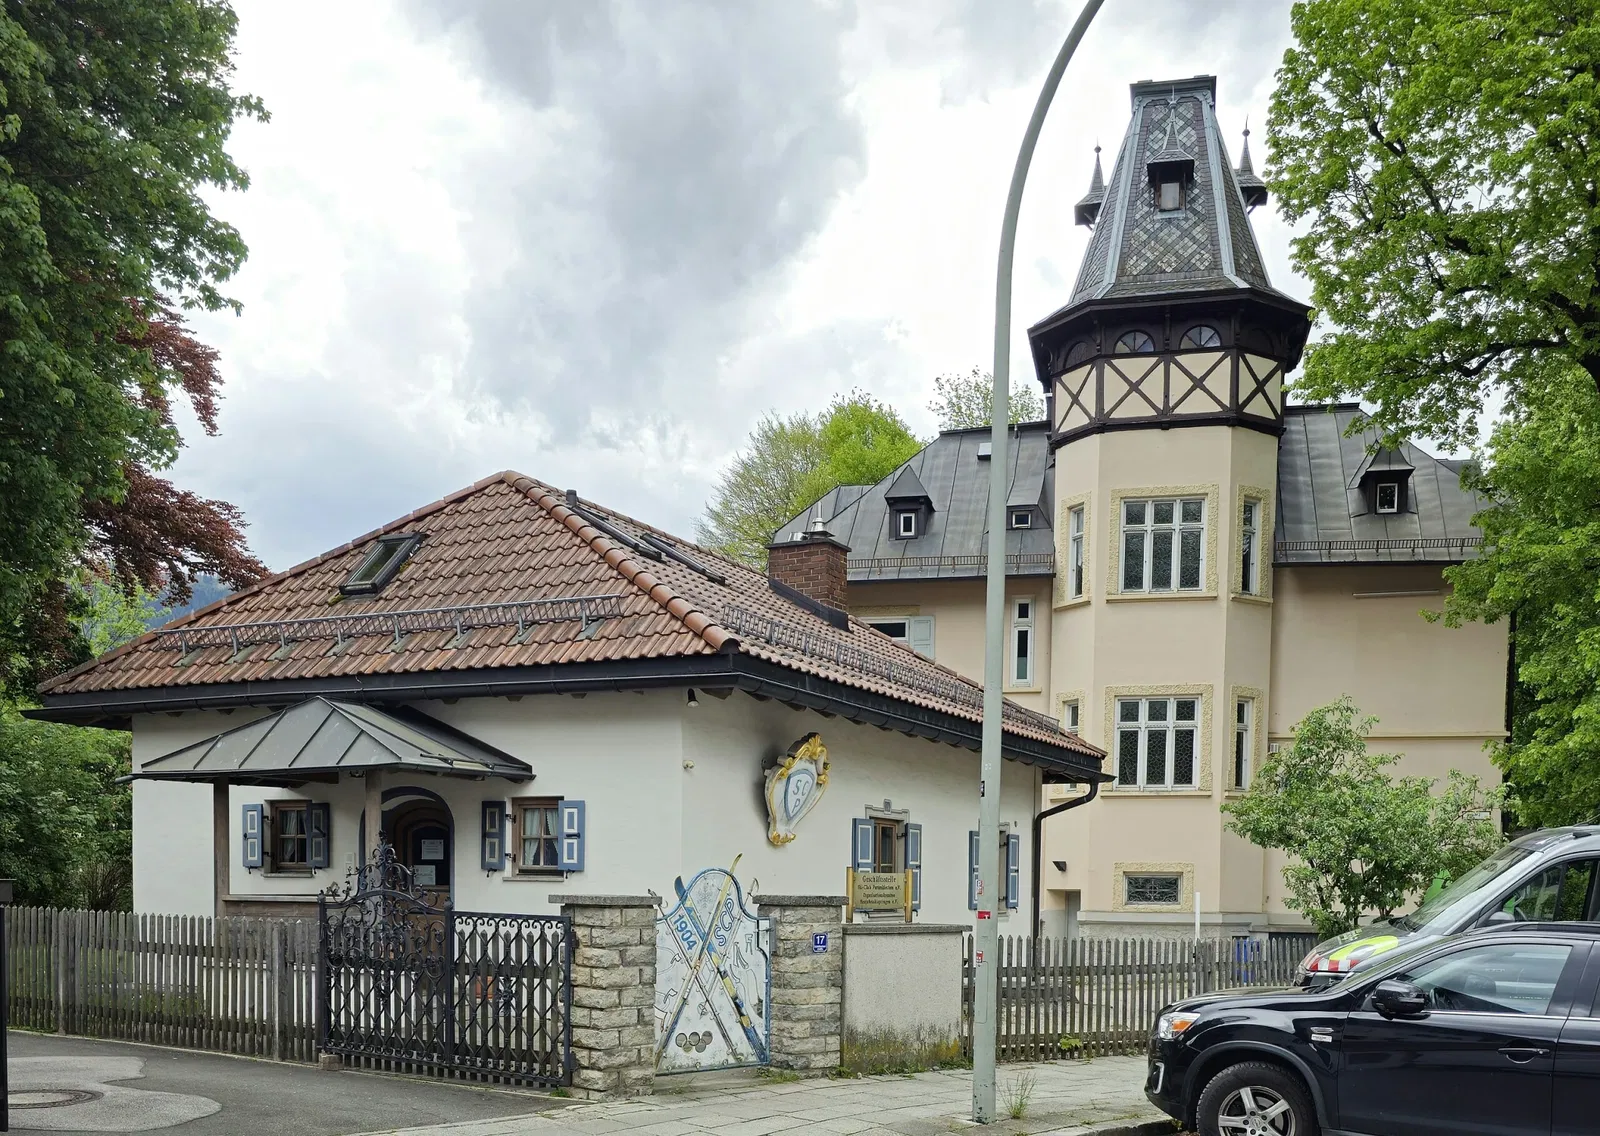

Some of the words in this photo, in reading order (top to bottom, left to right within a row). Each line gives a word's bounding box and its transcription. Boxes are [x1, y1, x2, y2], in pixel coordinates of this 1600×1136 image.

[792, 779, 809, 797] SC
[674, 914, 697, 950] 1904
[815, 935, 826, 945] 17
